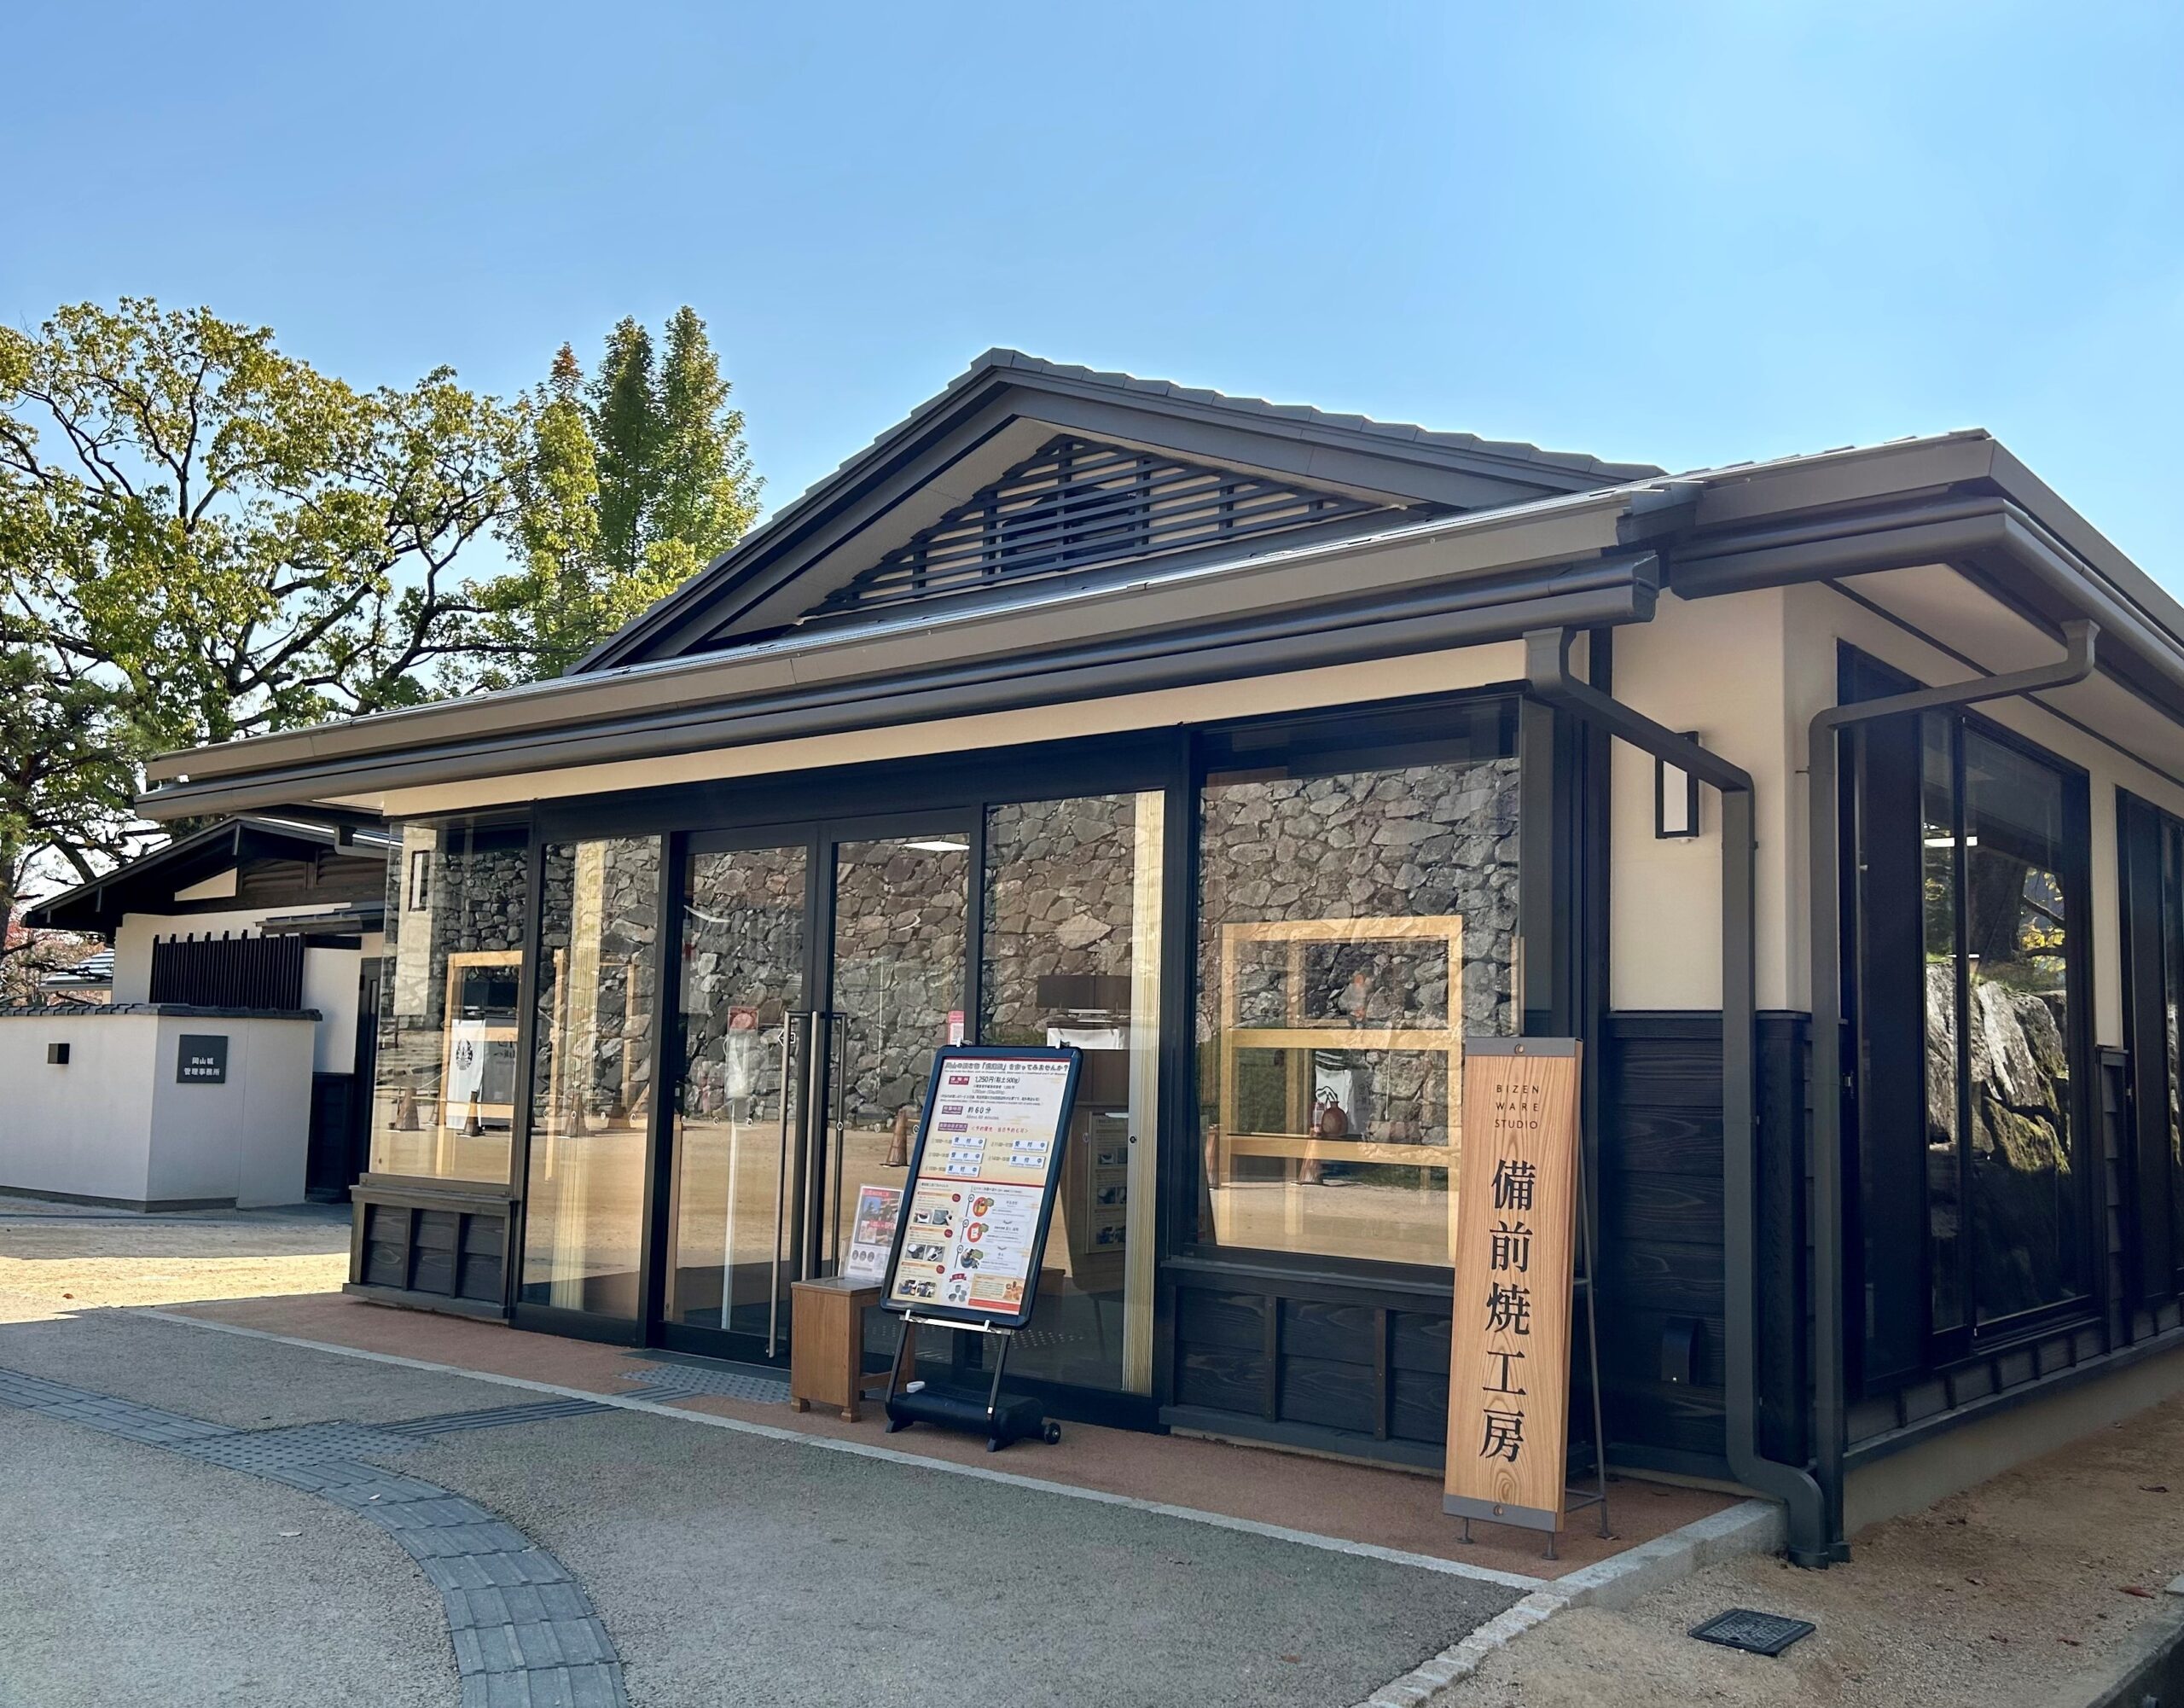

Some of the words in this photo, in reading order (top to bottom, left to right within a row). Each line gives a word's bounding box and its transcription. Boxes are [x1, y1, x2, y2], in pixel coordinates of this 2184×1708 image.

[191, 1056, 214, 1065] 岡山城
[183, 1067, 220, 1076] 管理事務所
[1496, 1084, 1540, 1095] BIZEN
[1495, 1101, 1540, 1112] WARE
[1494, 1118, 1538, 1130] STUDIO
[1479, 1159, 1536, 1462] 備前焼工房
